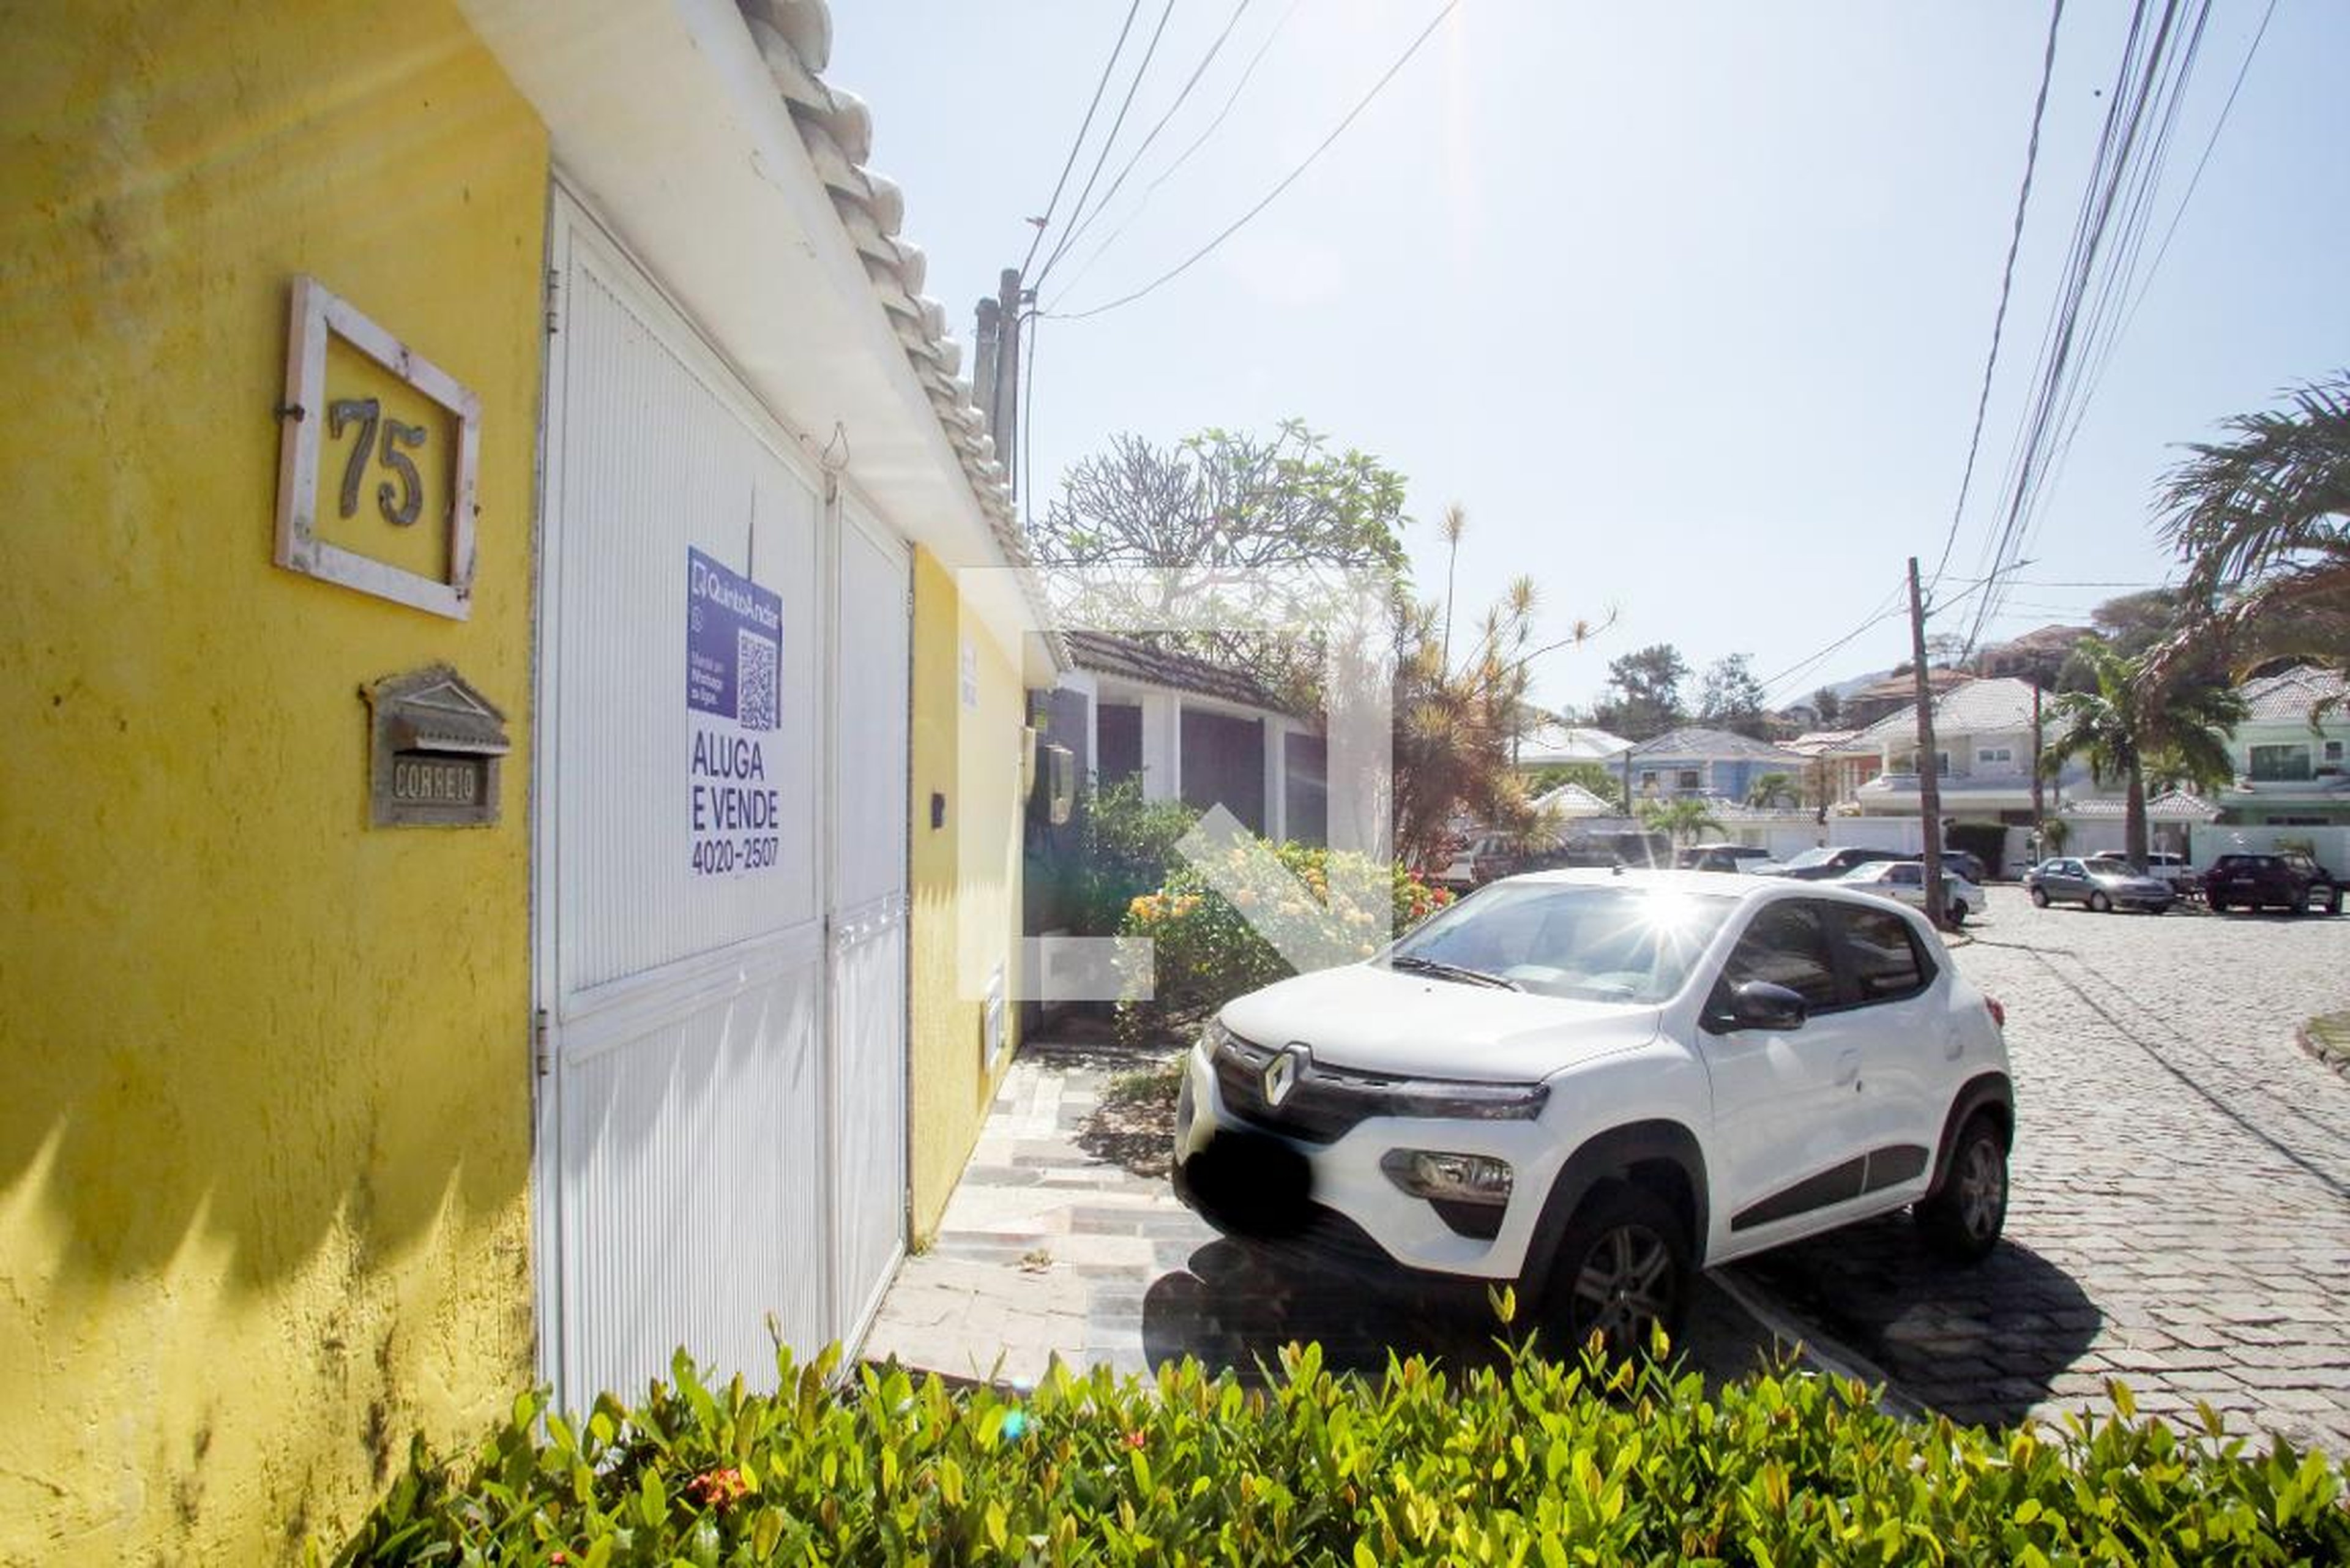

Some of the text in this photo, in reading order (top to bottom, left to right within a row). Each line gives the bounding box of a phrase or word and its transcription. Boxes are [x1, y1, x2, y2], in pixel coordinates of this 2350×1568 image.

[328, 397, 428, 528] 75
[692, 730, 764, 781] ALUGA
[395, 764, 475, 799] CORREIO
[693, 785, 778, 831] E VENDE
[692, 837, 779, 875] 4020-2507
